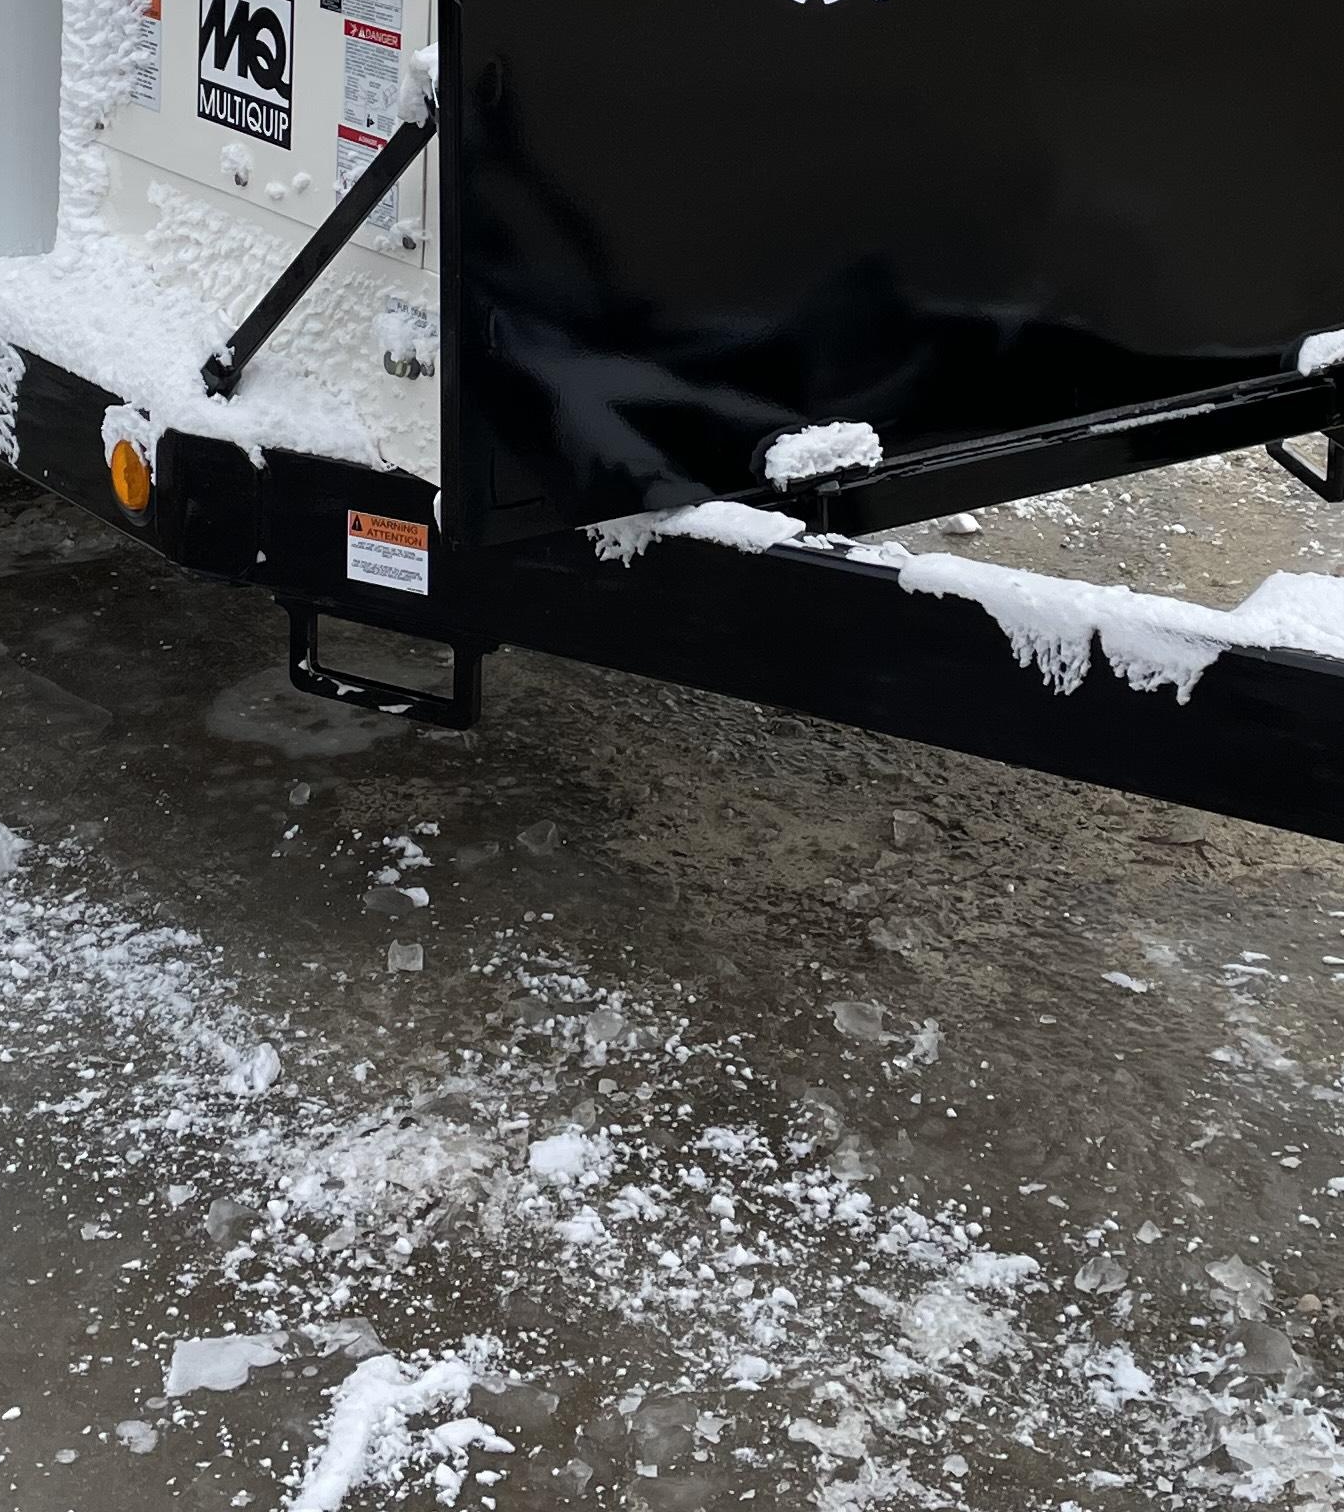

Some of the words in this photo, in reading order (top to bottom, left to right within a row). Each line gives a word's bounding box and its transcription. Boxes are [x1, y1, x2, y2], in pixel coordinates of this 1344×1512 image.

[199, 84, 289, 141] MULTIQUIP
[370, 518, 418, 535] WARNING
[367, 528, 423, 547] ATTENTION
